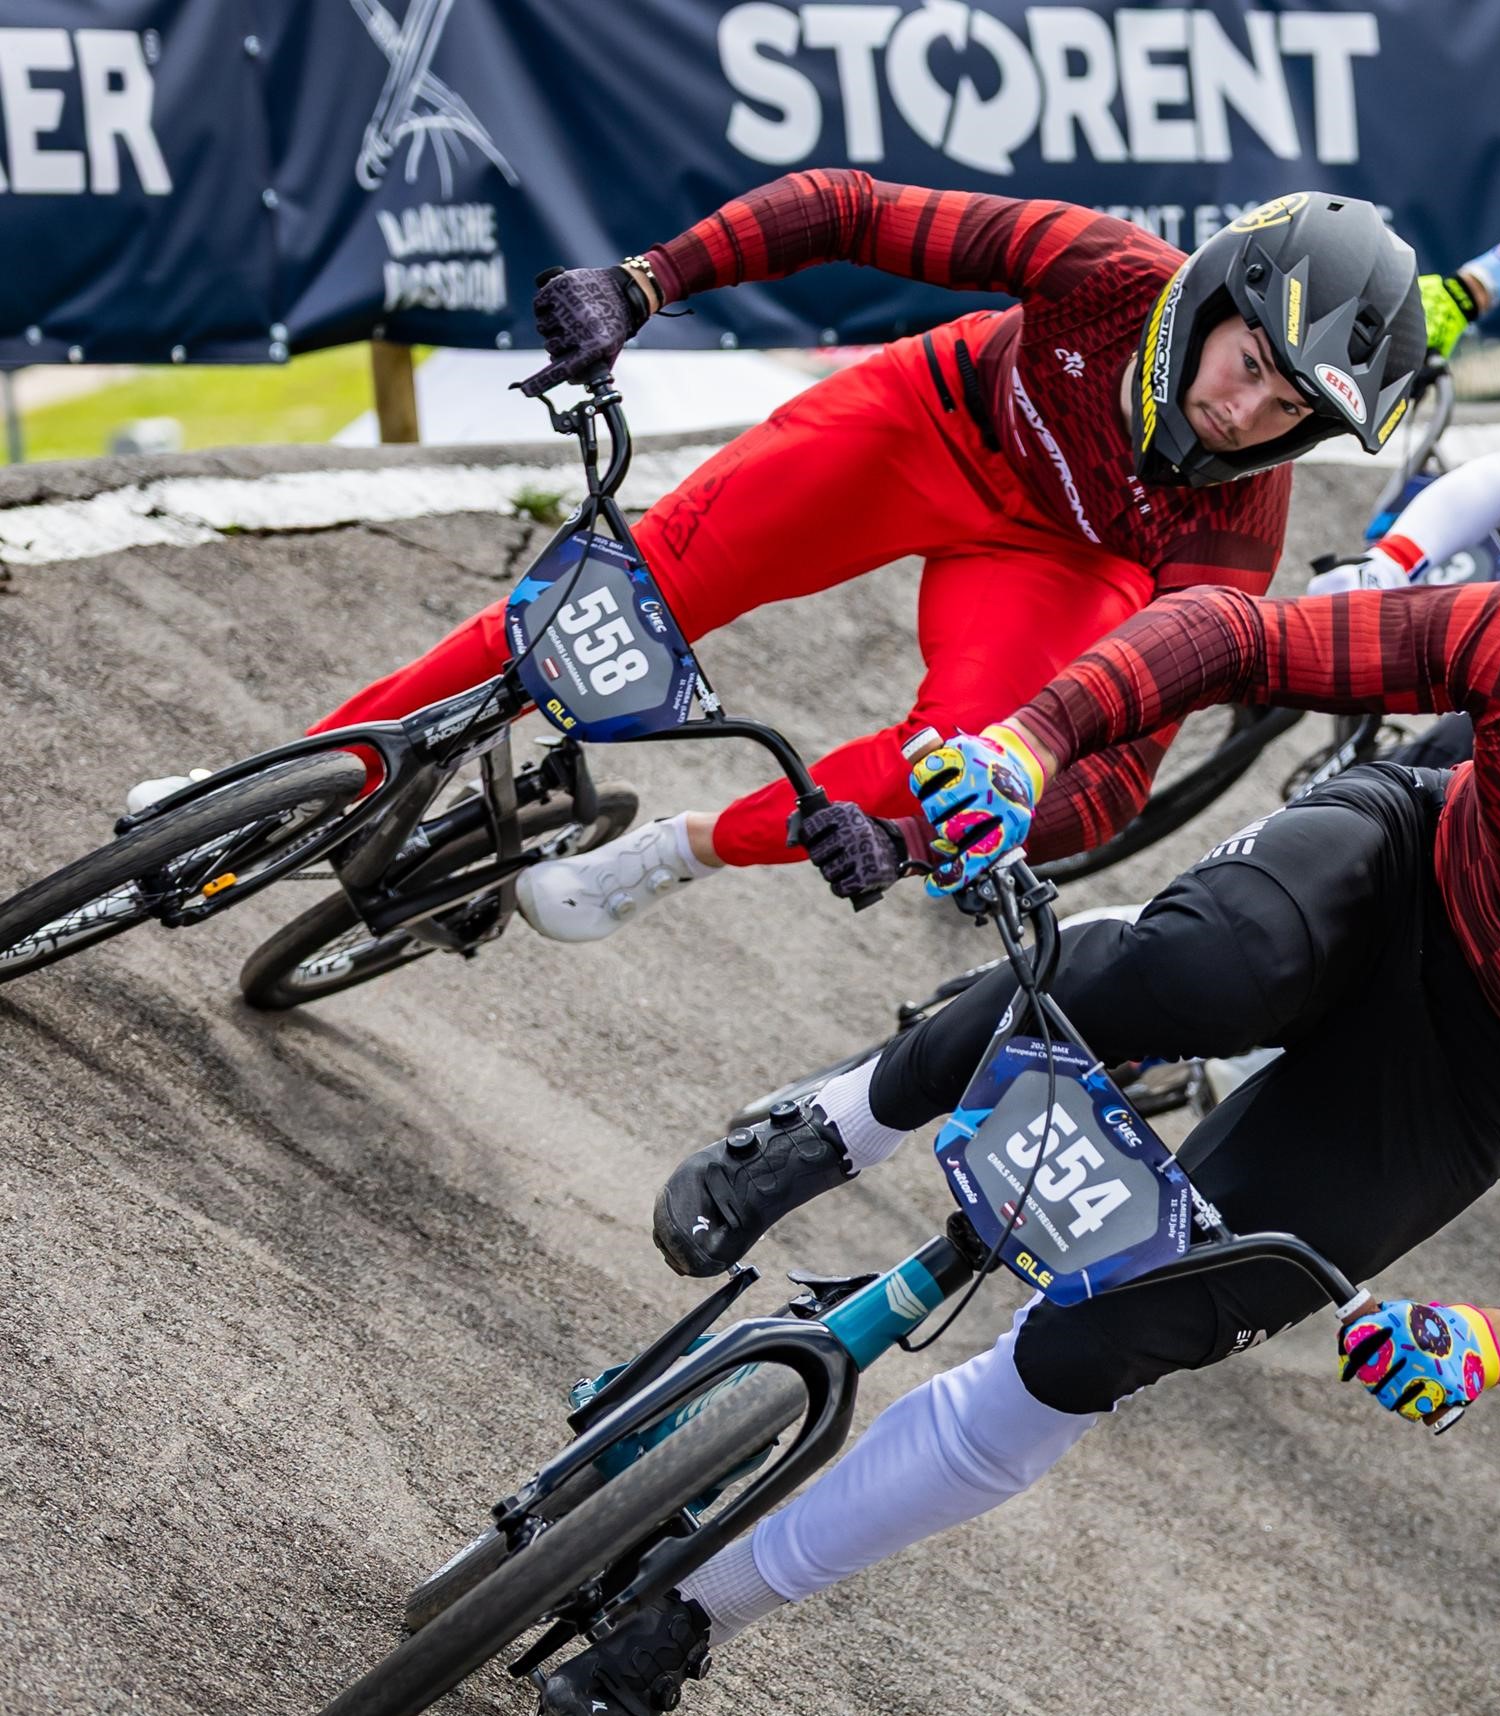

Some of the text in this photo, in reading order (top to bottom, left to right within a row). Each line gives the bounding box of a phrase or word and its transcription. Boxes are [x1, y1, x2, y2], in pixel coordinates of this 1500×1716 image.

[716, 0, 1381, 175] STORENT
[0, 26, 175, 196] ER
[1325, 370, 1361, 415] BELL
[556, 585, 649, 697] 558
[648, 611, 668, 634] UEC
[1005, 1045, 1089, 1067] European Chmpionships
[1030, 1040, 1070, 1055] 202 BMX
[1119, 1122, 1143, 1148] UEC
[951, 1166, 978, 1205] vittoria
[1005, 1101, 1133, 1239] 554
[987, 1152, 1011, 1178] EMILS
[1034, 1206, 1070, 1253] TREIMANIS
[1179, 1187, 1188, 1230] VALMIERA
